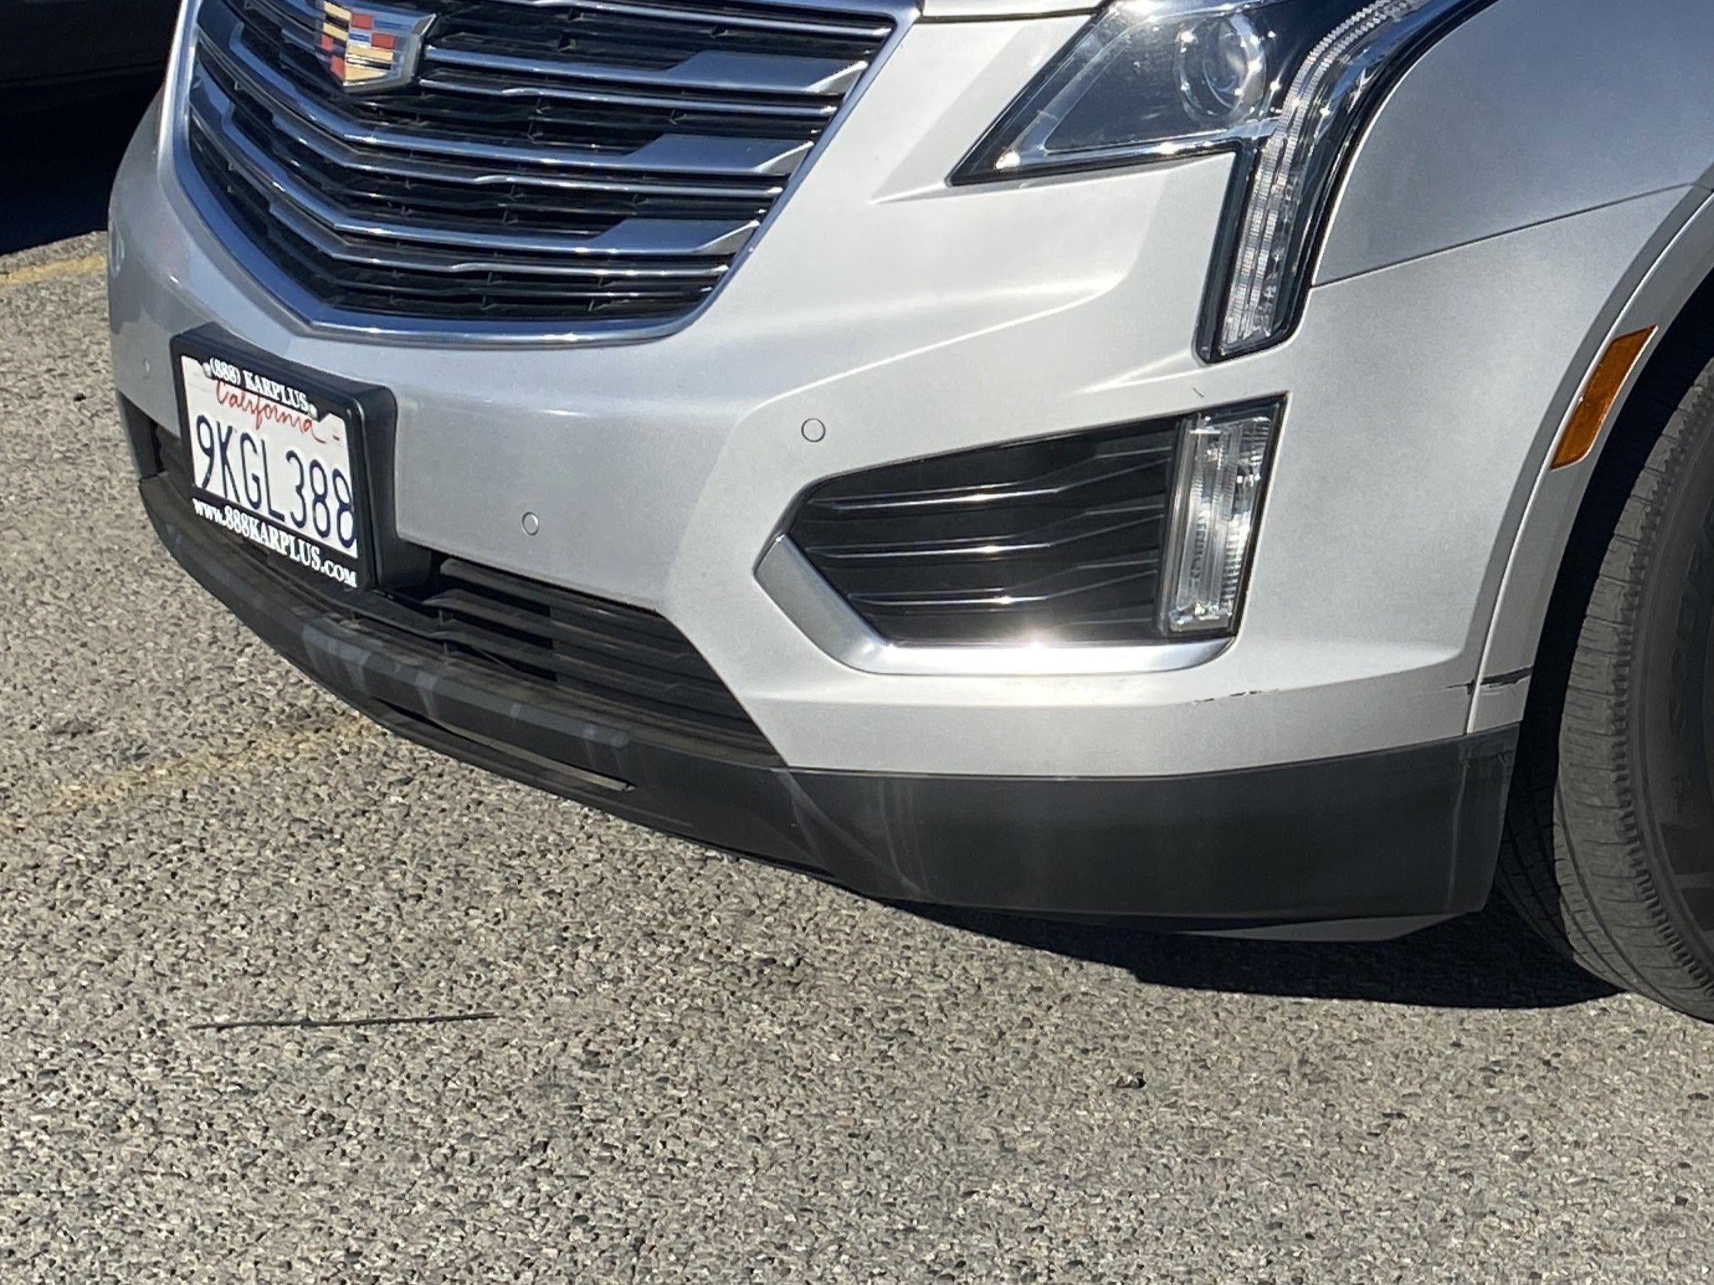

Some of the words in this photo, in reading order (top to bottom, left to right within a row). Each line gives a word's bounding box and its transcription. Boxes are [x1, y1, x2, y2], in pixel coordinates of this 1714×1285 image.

[210, 358, 241, 386] (888)
[244, 371, 309, 414] KARPLUS
[215, 380, 327, 444] California
[196, 415, 357, 549] 9KGL388
